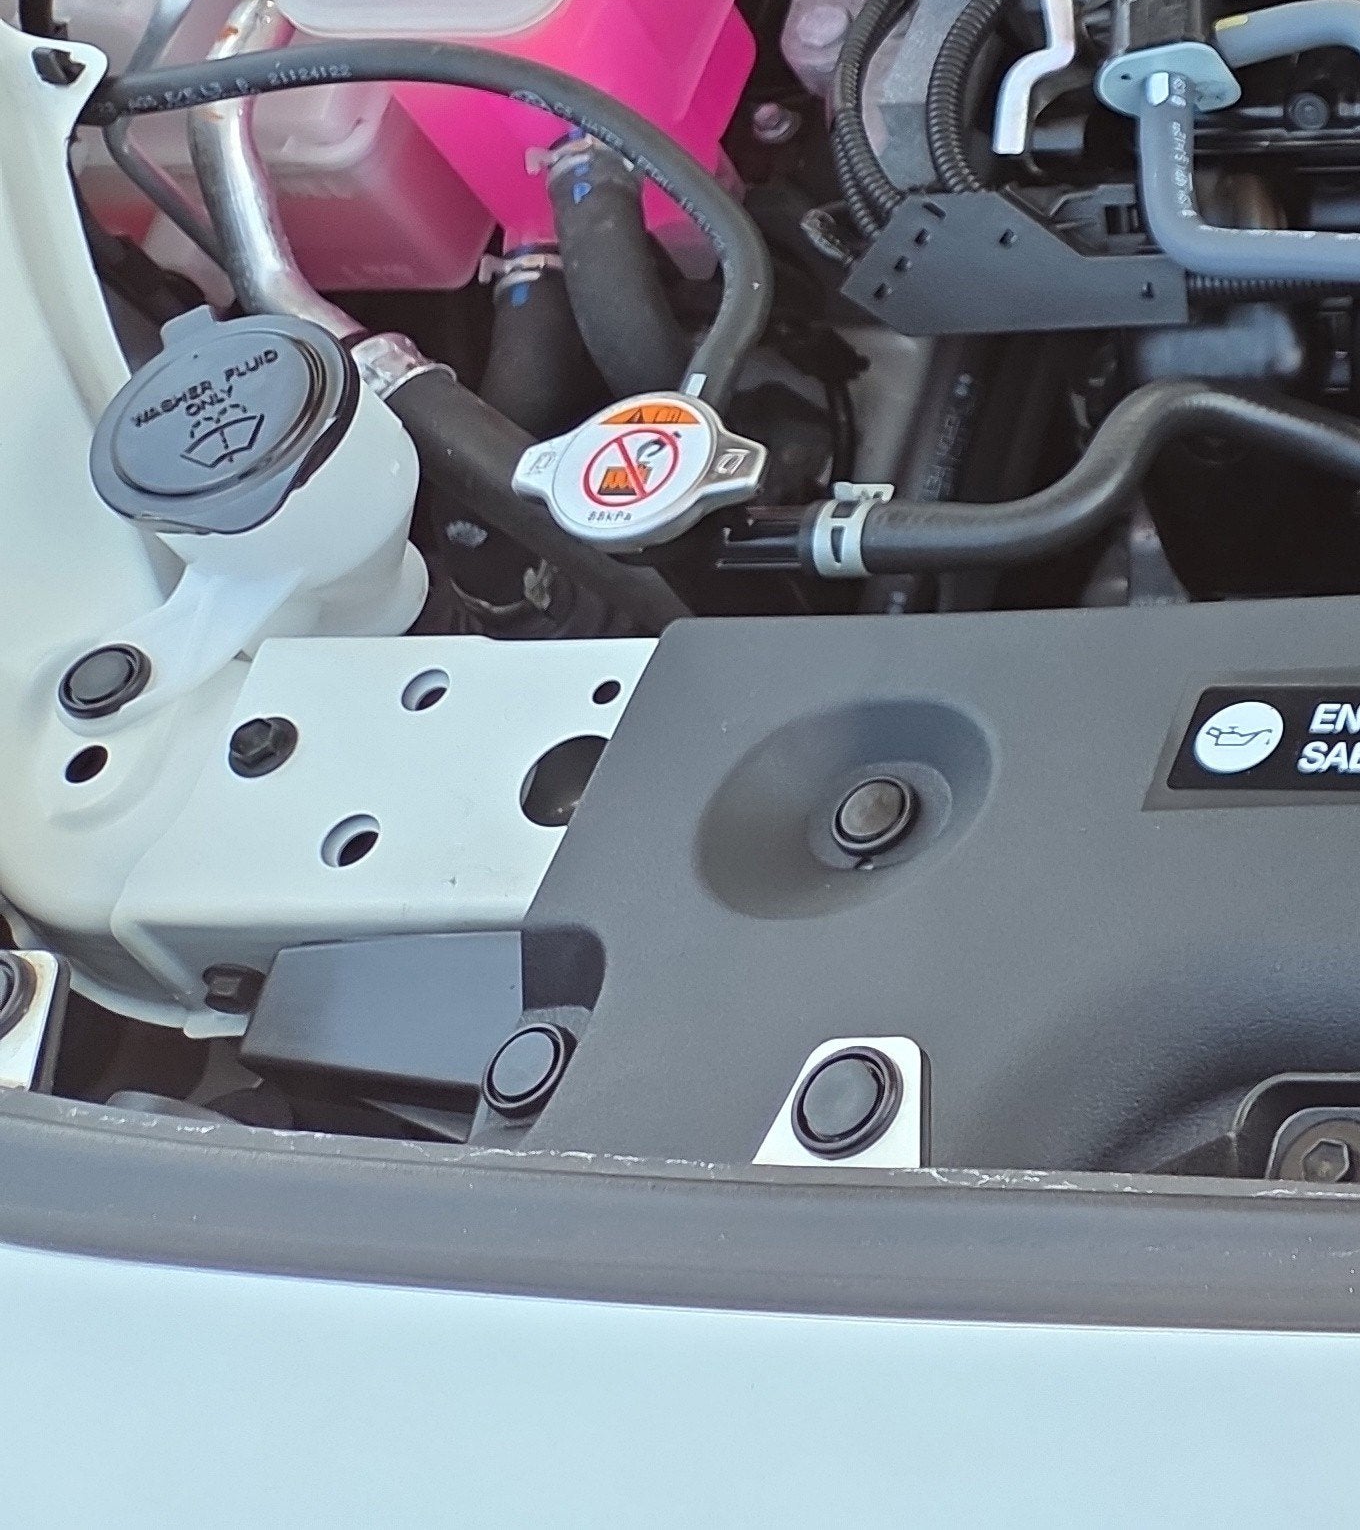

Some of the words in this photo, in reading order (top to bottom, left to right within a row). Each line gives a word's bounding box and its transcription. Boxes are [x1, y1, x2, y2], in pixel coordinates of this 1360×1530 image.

[131, 380, 213, 428] WASHER
[223, 349, 279, 382] FLUID
[185, 384, 233, 417] ONLY
